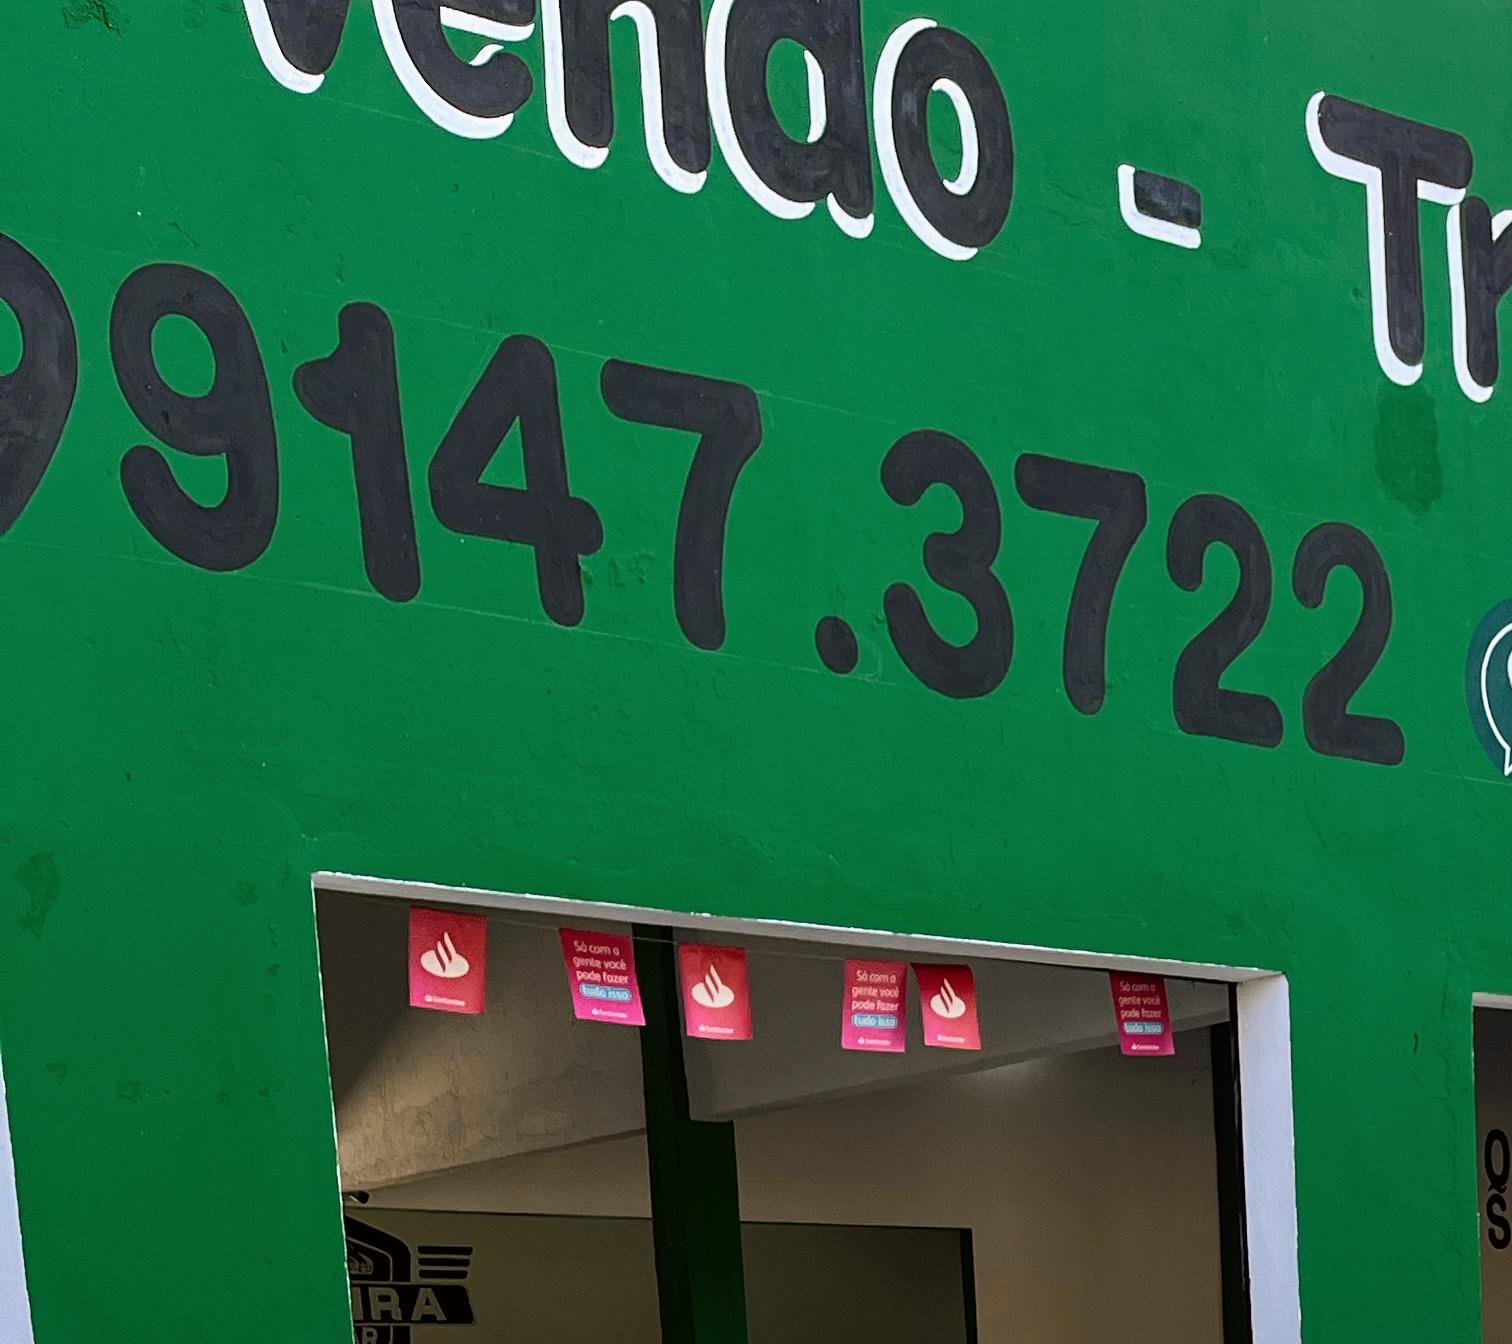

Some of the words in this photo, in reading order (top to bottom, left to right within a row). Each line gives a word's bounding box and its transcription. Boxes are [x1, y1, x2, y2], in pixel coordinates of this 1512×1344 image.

[589, 945, 611, 956] com
[573, 956, 601, 968] gente
[576, 970, 602, 982] pode
[603, 971, 629, 984] fazer
[869, 973, 888, 983] com
[852, 985, 878, 998] gente
[851, 999, 876, 1011] pode
[877, 999, 900, 1011] fazer
